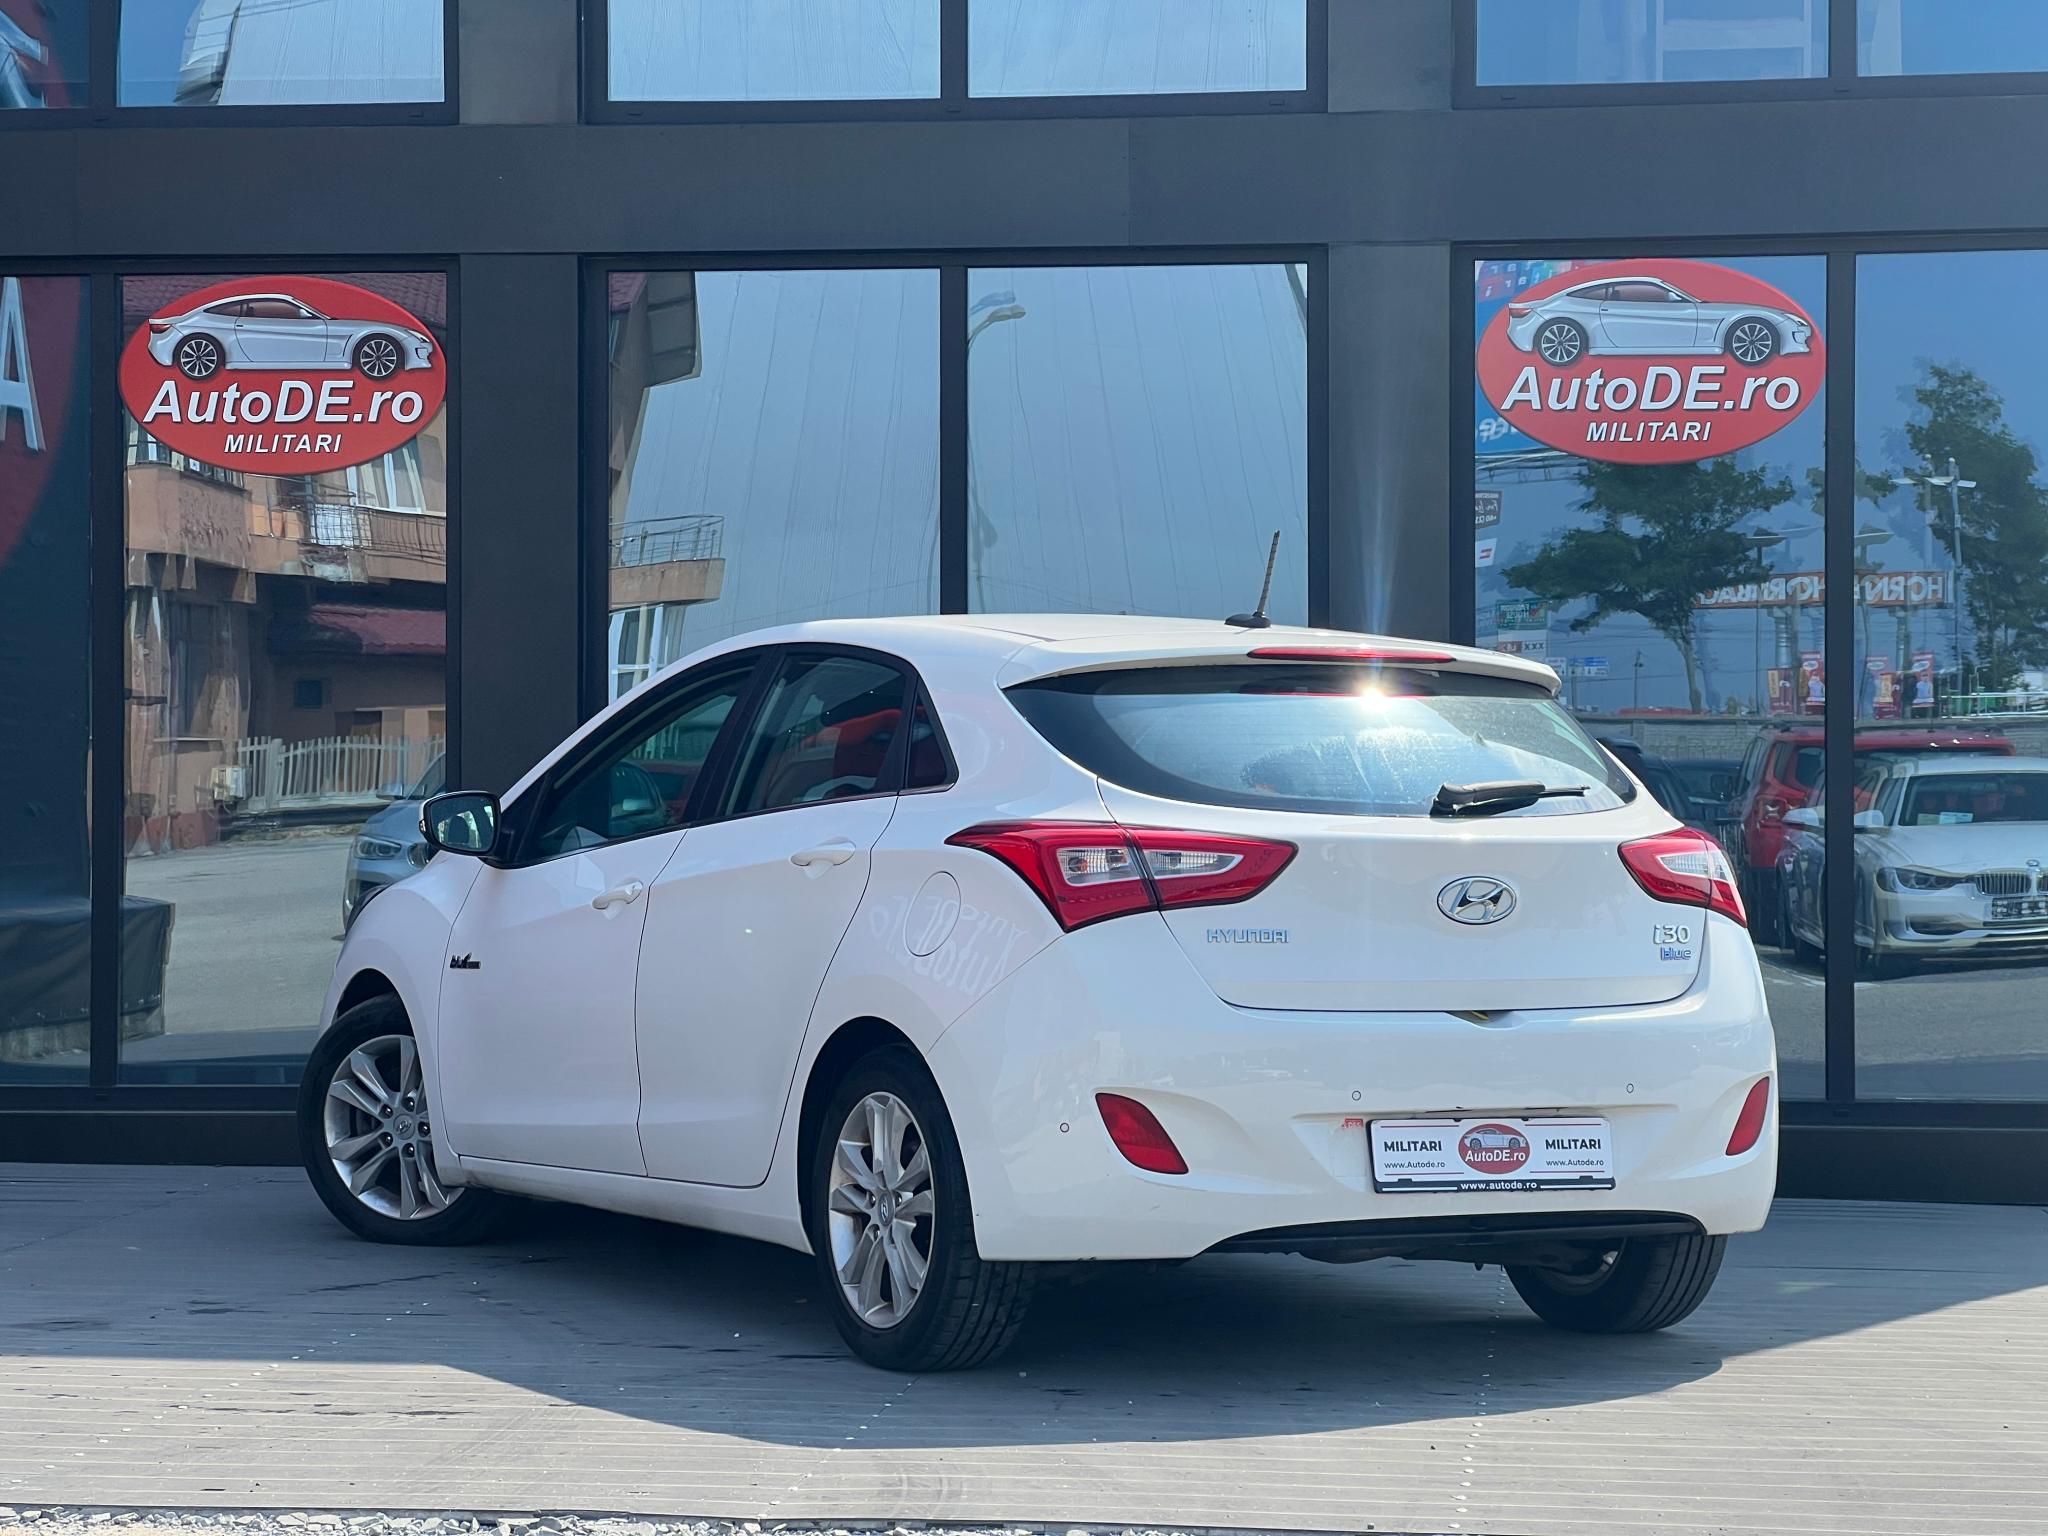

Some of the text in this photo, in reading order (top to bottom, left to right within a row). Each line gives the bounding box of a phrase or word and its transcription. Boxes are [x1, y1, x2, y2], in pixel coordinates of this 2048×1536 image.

[1501, 365, 1800, 410] AutoDE.ro
[143, 380, 423, 424] AutoDE.ro
[1586, 421, 1712, 441] MILITARI
[223, 434, 342, 453] MILITARI
[1207, 928, 1289, 943] HYUNDAI
[1653, 924, 1690, 944] i30
[1661, 946, 1691, 960] blue
[1383, 1140, 1442, 1152] MILITARI
[1545, 1138, 1601, 1150] MILITARI
[1465, 1149, 1526, 1162] AutoDE.ro
[1545, 1157, 1605, 1167] www.Autode.ro
[1384, 1159, 1446, 1169] www.Autode.ro
[1460, 1181, 1537, 1191] www.autode.ro
